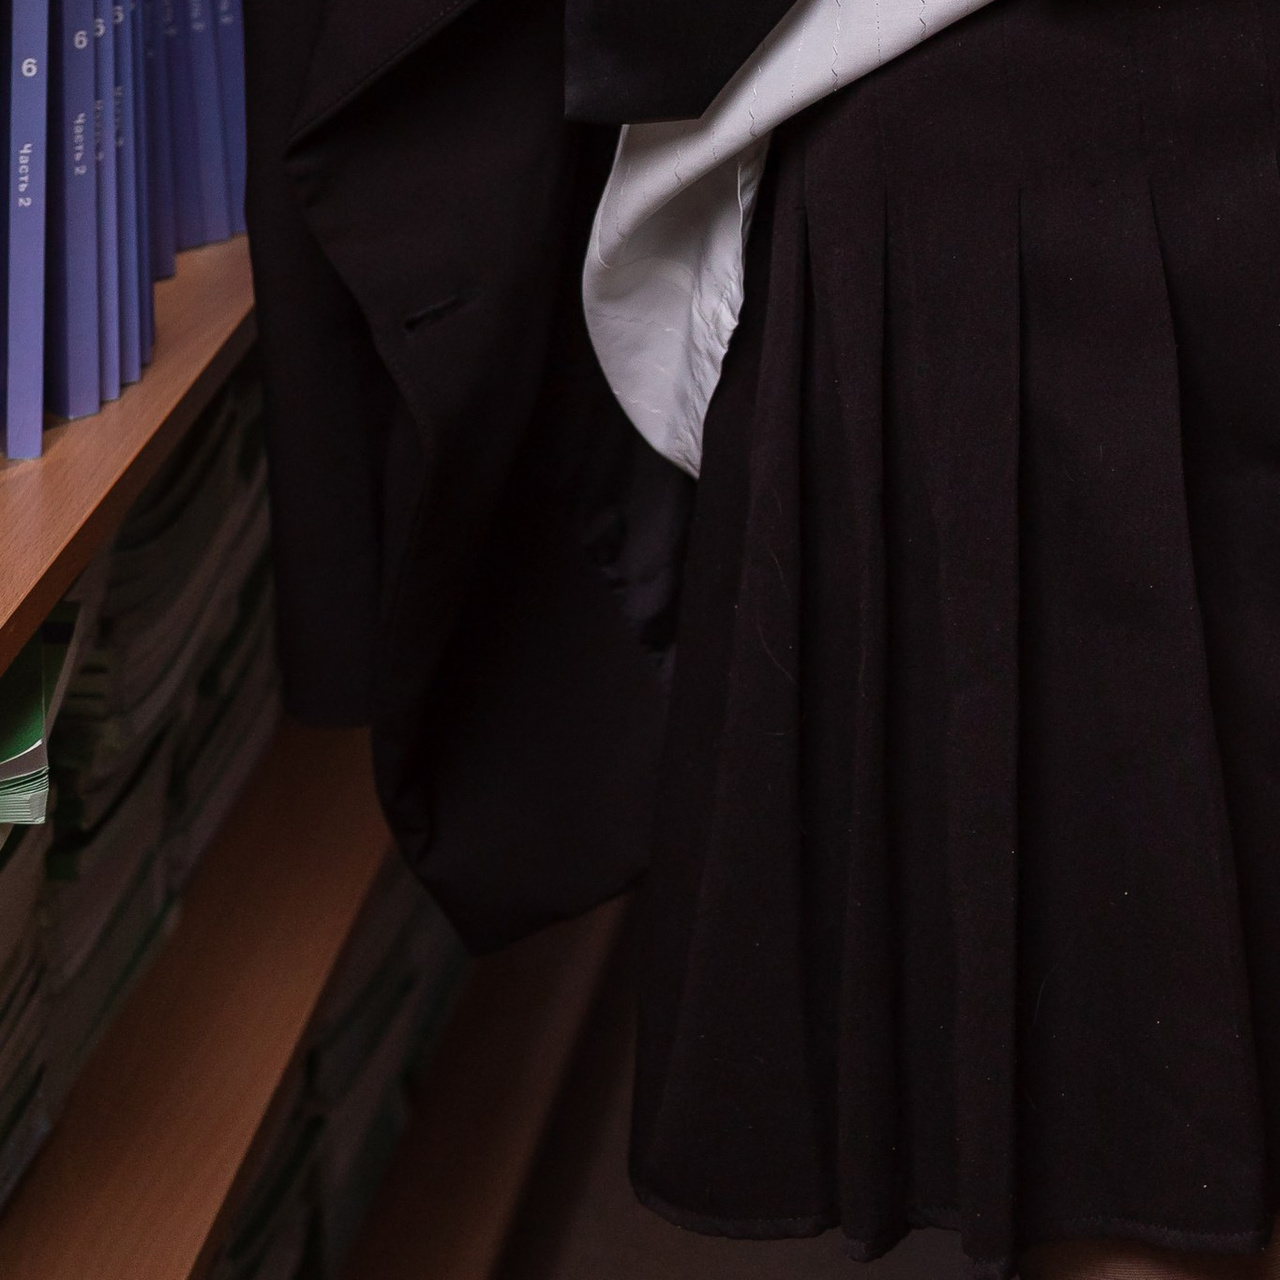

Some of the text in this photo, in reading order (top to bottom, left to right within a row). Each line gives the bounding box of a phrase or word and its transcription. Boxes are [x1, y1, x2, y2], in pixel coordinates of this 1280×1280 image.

[73, 30, 88, 49] 6
[21, 58, 37, 77] 6
[73, 113, 87, 176] Часть 2
[18, 143, 33, 207] Часть 2
